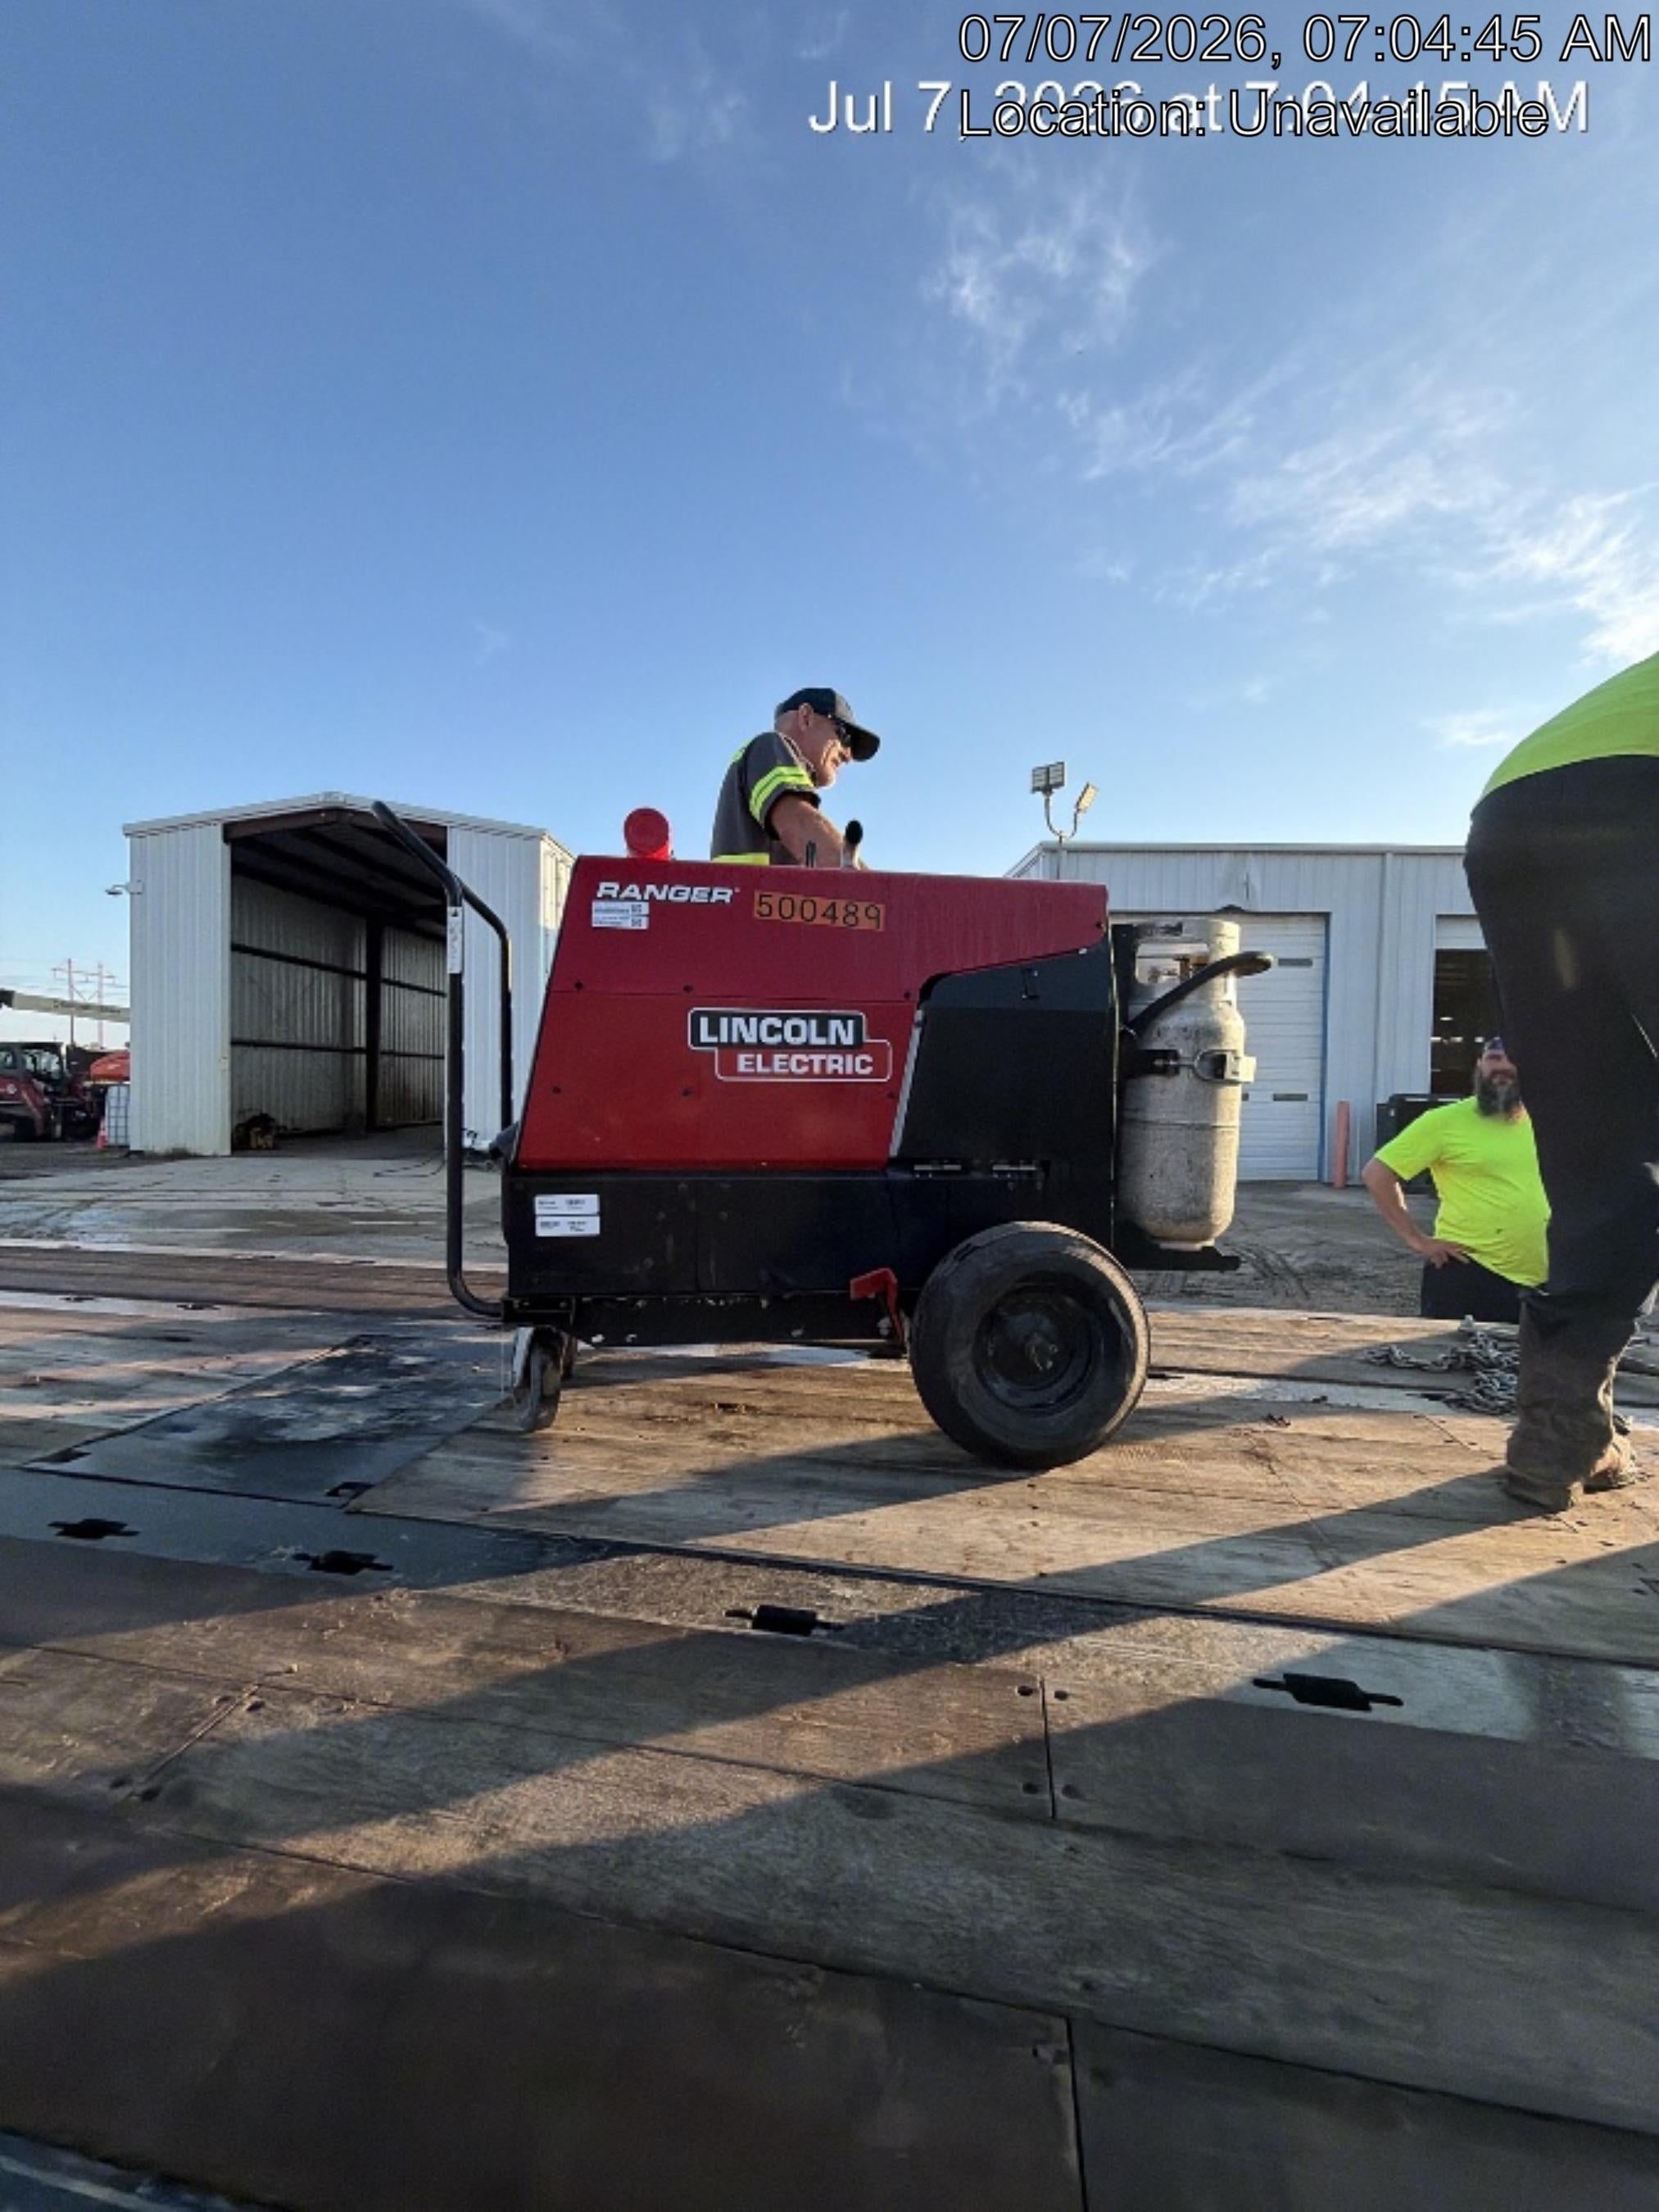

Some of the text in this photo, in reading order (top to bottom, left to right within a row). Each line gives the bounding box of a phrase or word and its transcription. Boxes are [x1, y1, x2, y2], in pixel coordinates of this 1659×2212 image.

[596, 882, 733, 903] RANGER
[755, 894, 882, 931] 500489
[699, 1016, 855, 1045] LINCOLN
[737, 1053, 874, 1075] ELECTRIC
